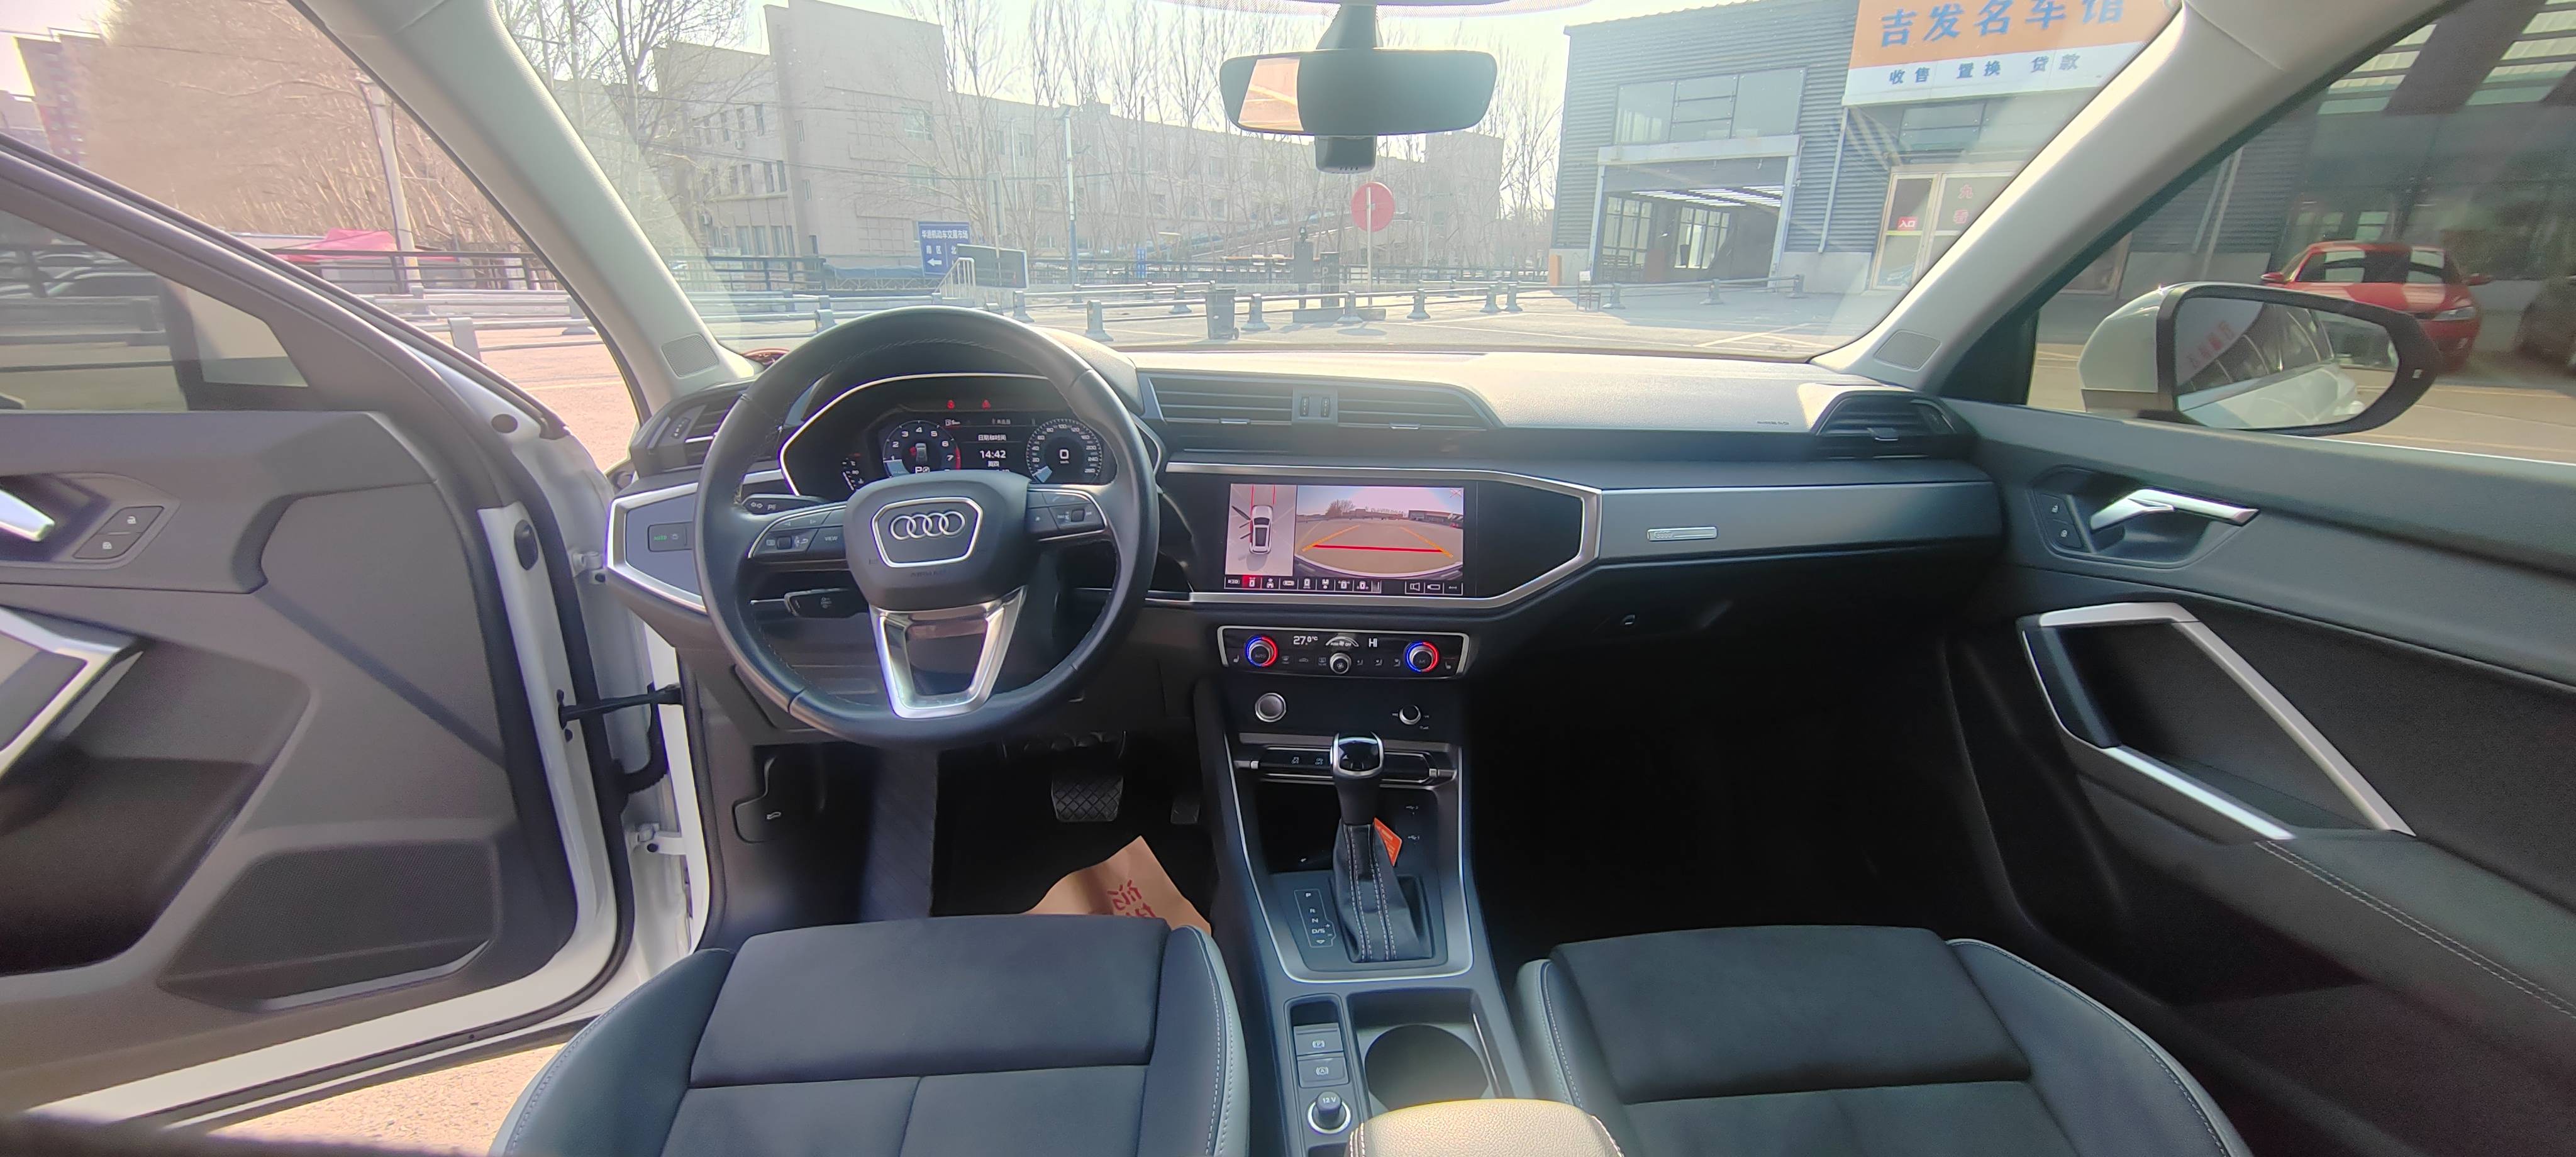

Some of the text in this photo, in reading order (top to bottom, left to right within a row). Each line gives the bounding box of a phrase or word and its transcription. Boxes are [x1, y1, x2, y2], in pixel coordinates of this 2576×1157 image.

[1880, 0, 2124, 48] 吉发名车馆
[1889, 55, 2079, 86] 收售 置换 贷款
[1898, 219, 1916, 228] 入口
[980, 450, 1006, 459] 14:42
[1059, 448, 1069, 460] 0
